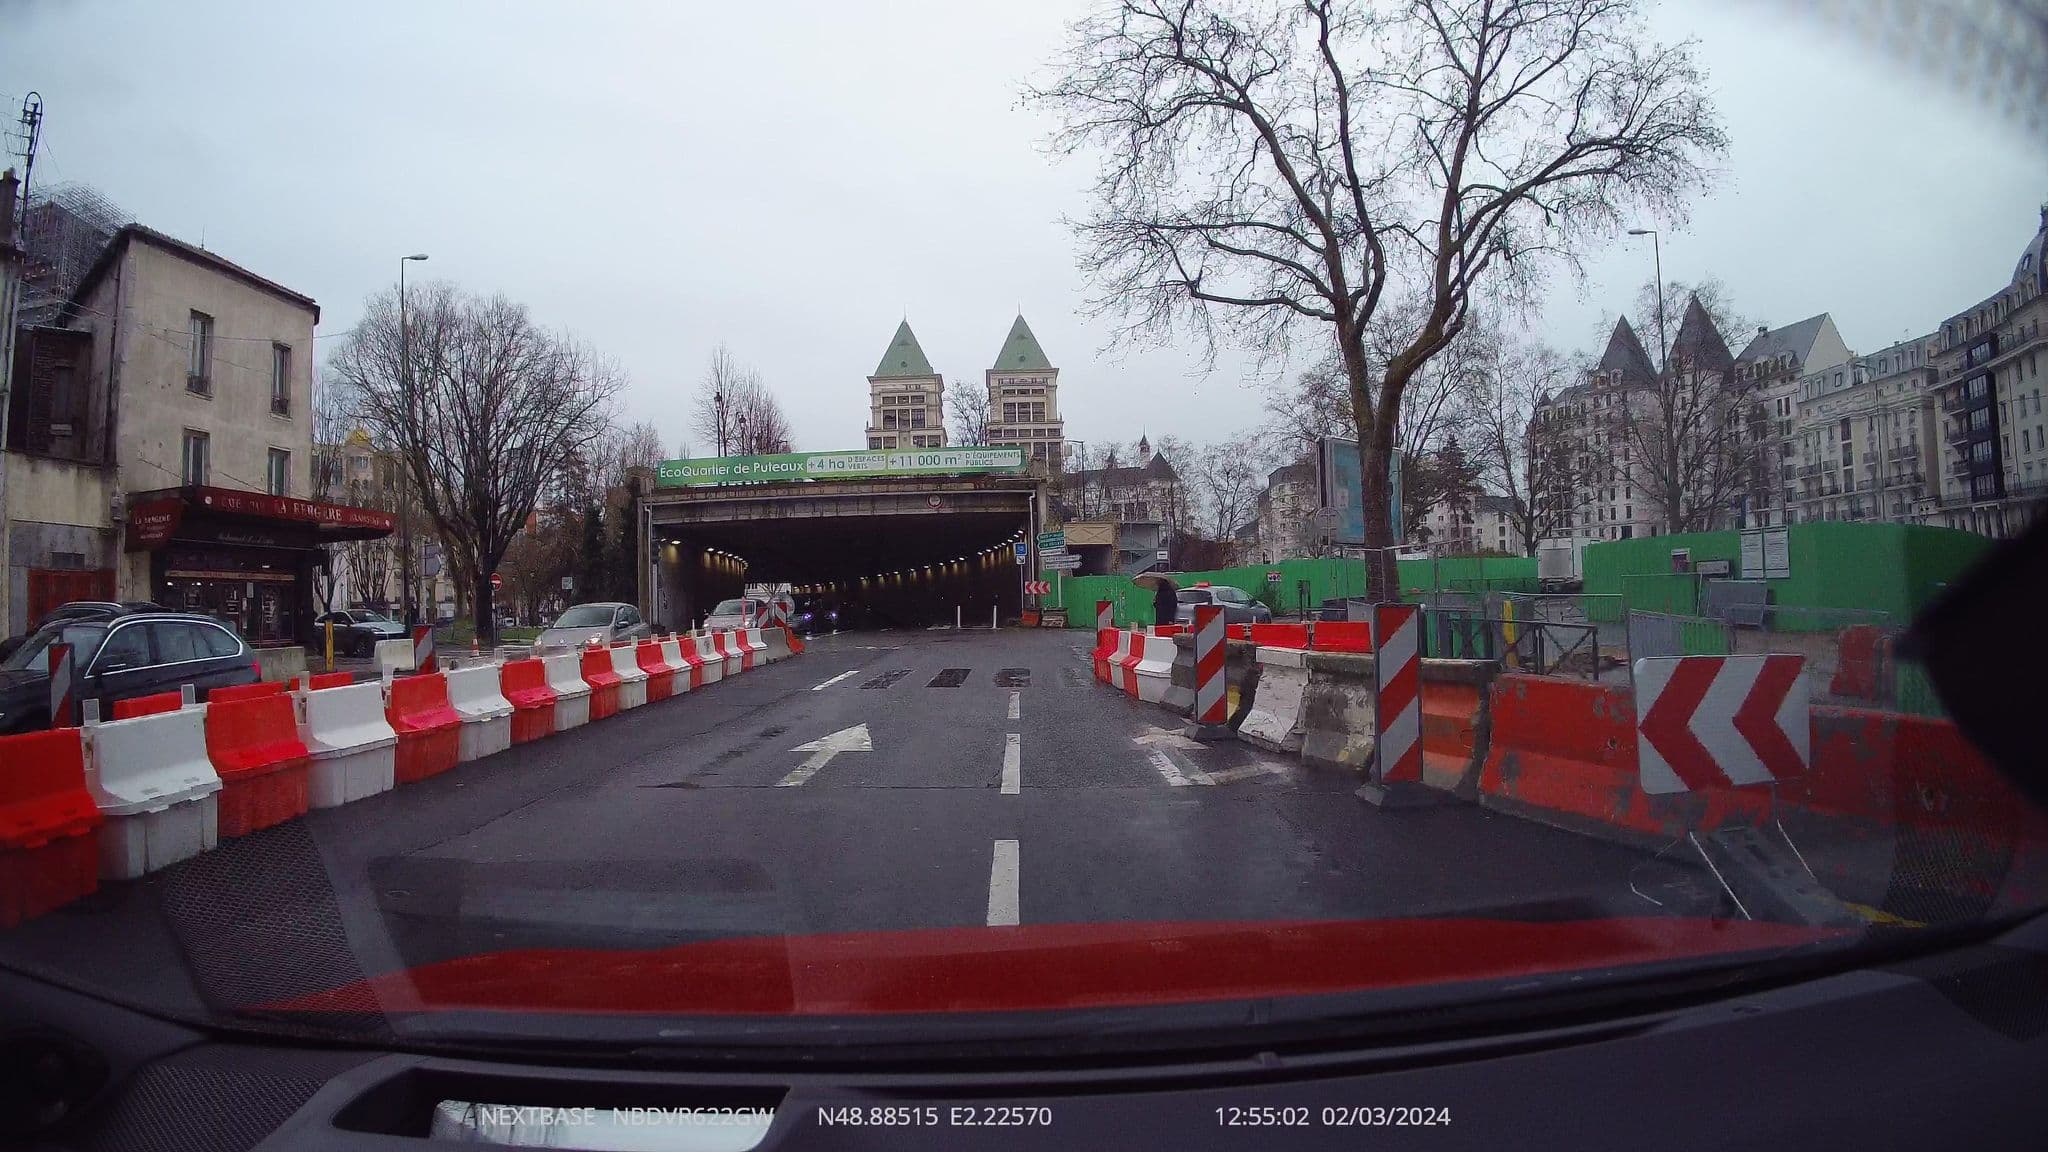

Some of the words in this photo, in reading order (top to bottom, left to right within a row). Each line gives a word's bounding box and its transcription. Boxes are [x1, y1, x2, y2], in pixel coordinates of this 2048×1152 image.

[828, 457, 845, 470] ha
[848, 462, 868, 470] VERTS
[917, 454, 940, 466] 000
[965, 457, 994, 467] PUBLICS
[660, 465, 730, 478] ÉcoQuartier
[733, 464, 750, 475] de
[753, 461, 805, 475] Puteaux
[293, 502, 343, 521] BERGRE
